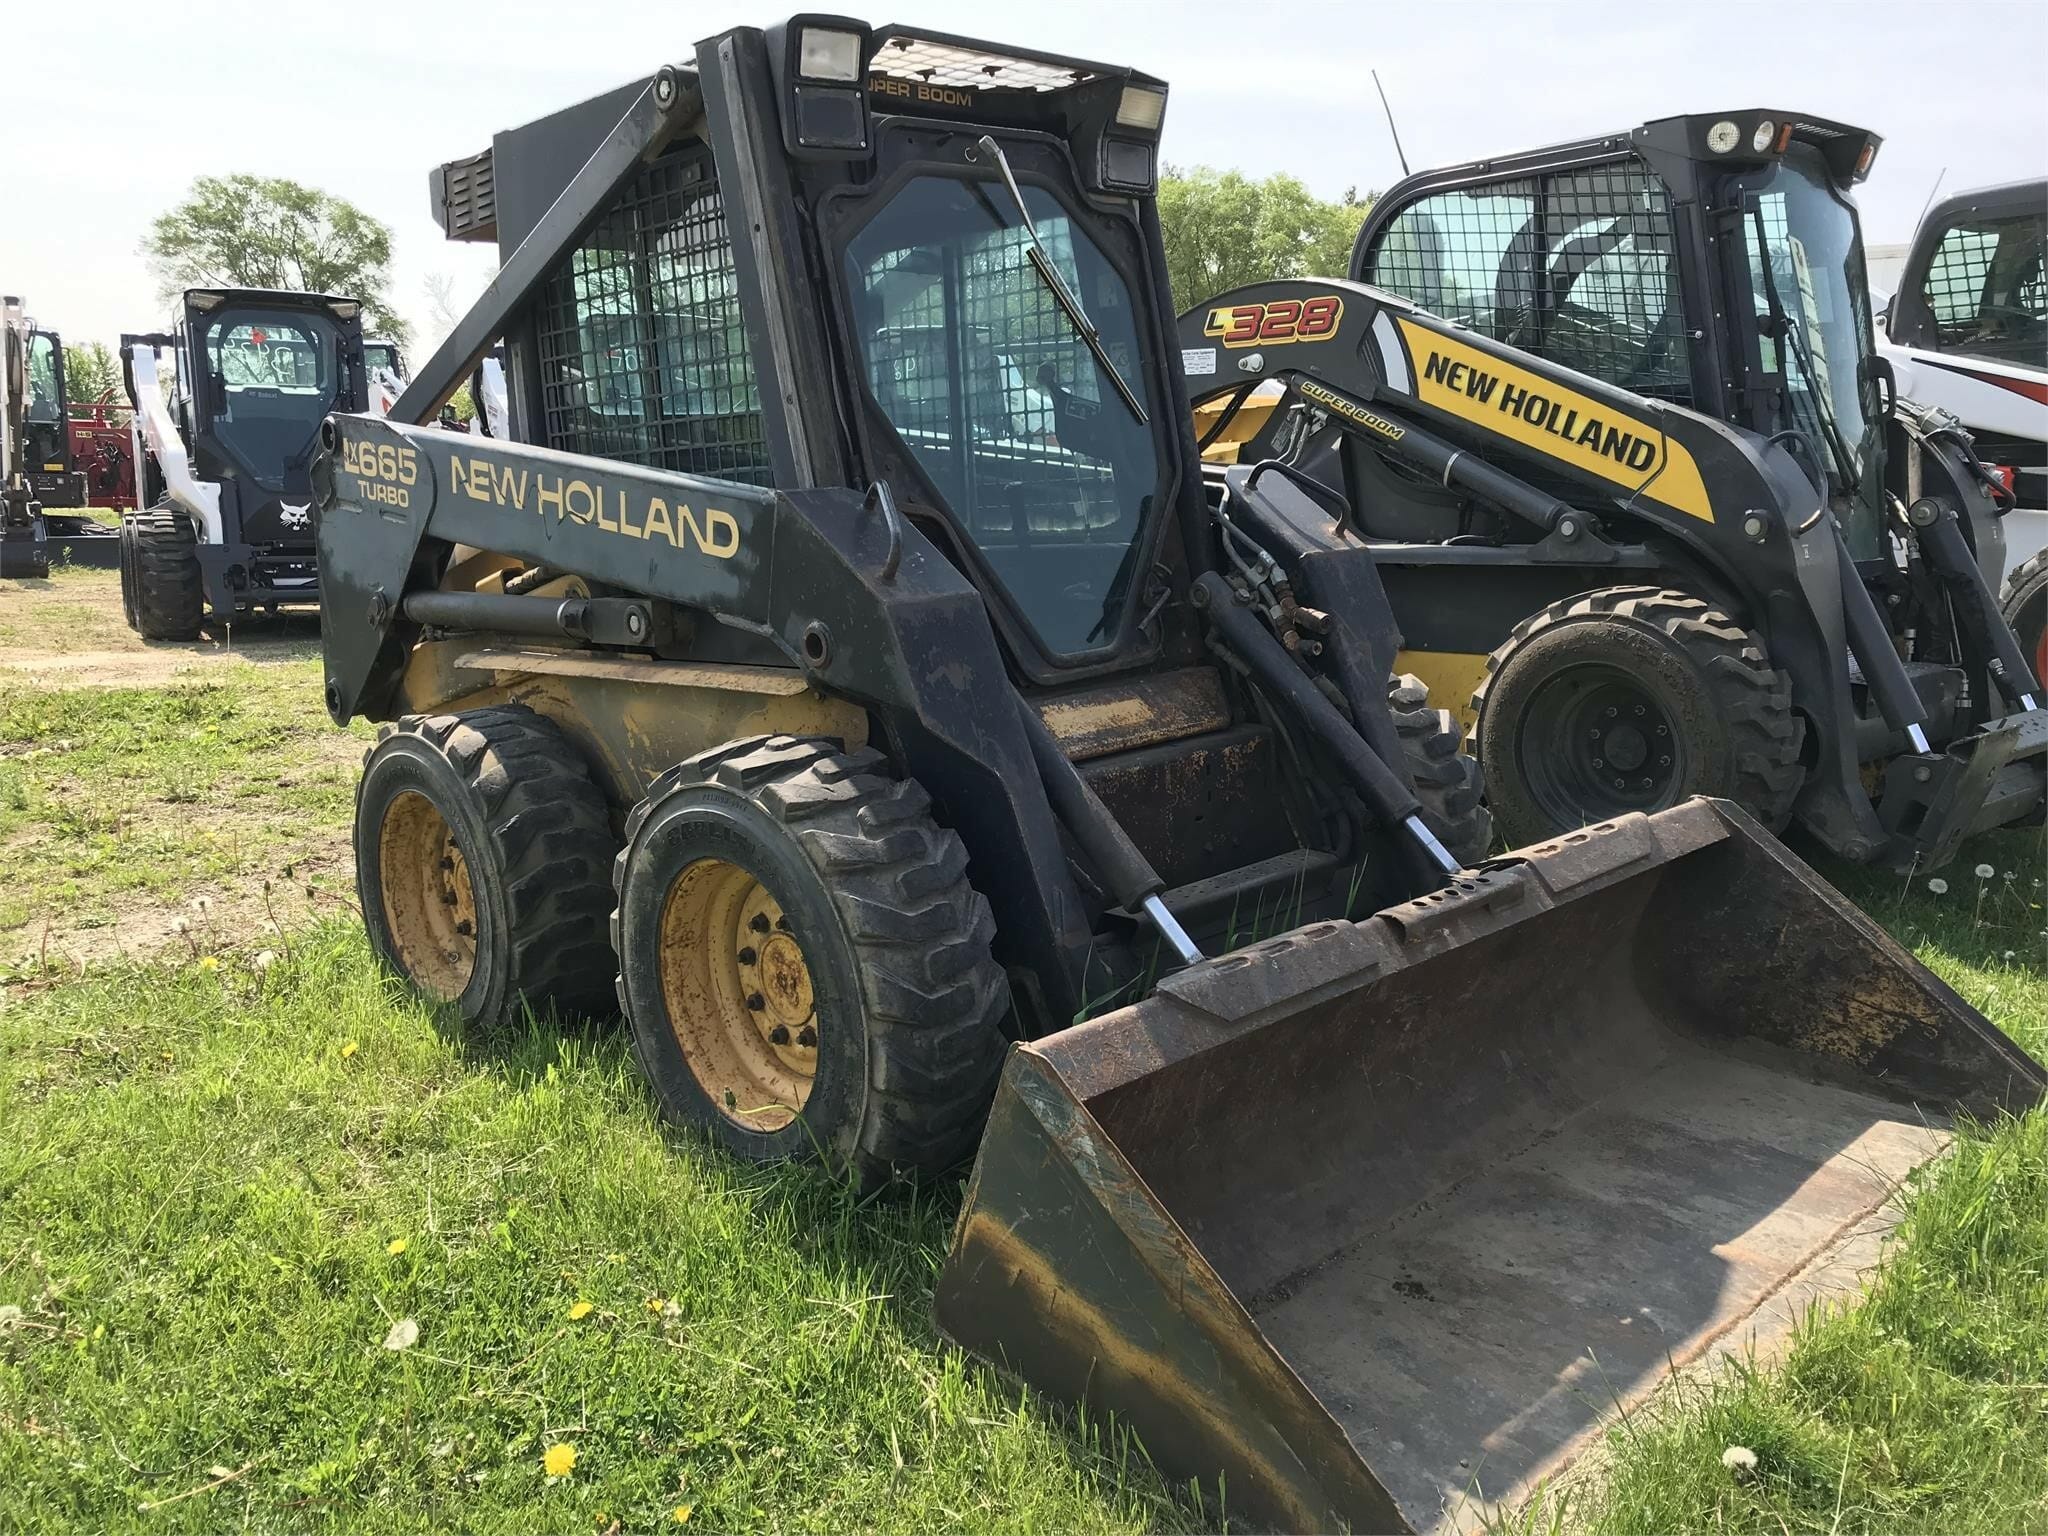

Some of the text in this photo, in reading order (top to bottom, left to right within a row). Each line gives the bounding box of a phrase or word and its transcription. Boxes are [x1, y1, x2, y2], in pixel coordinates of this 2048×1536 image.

[867, 77, 972, 107] UPER BOOM
[1204, 296, 1344, 348] L328
[1301, 381, 1406, 441] SUPER BOOM
[1424, 351, 1657, 473] NEW HOLLAND
[357, 479, 409, 508] TURBO
[451, 455, 740, 560] NEW HOLLAND
